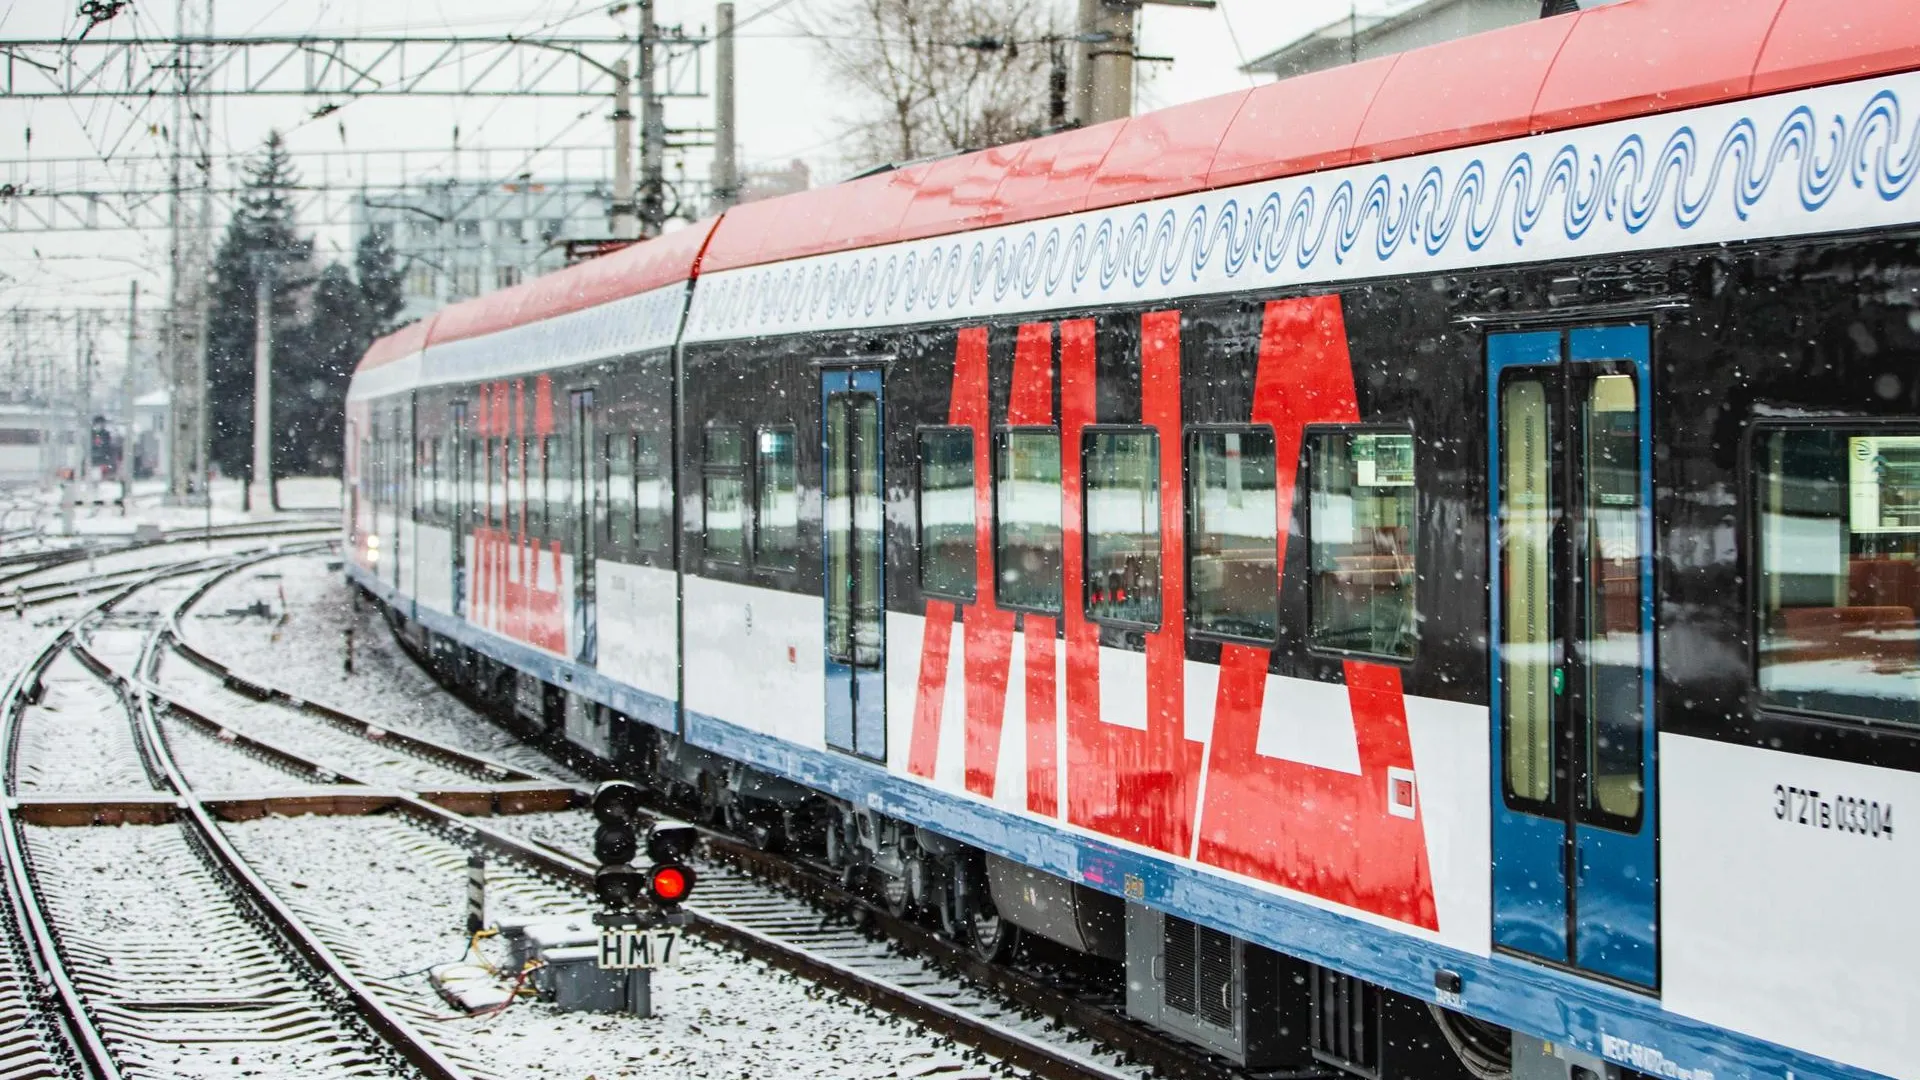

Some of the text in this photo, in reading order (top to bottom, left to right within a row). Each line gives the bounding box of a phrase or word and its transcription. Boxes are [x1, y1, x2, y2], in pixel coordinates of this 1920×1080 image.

[907, 294, 1440, 932] МЦД
[1774, 784, 1893, 841] ЭГ2Тв 03304
